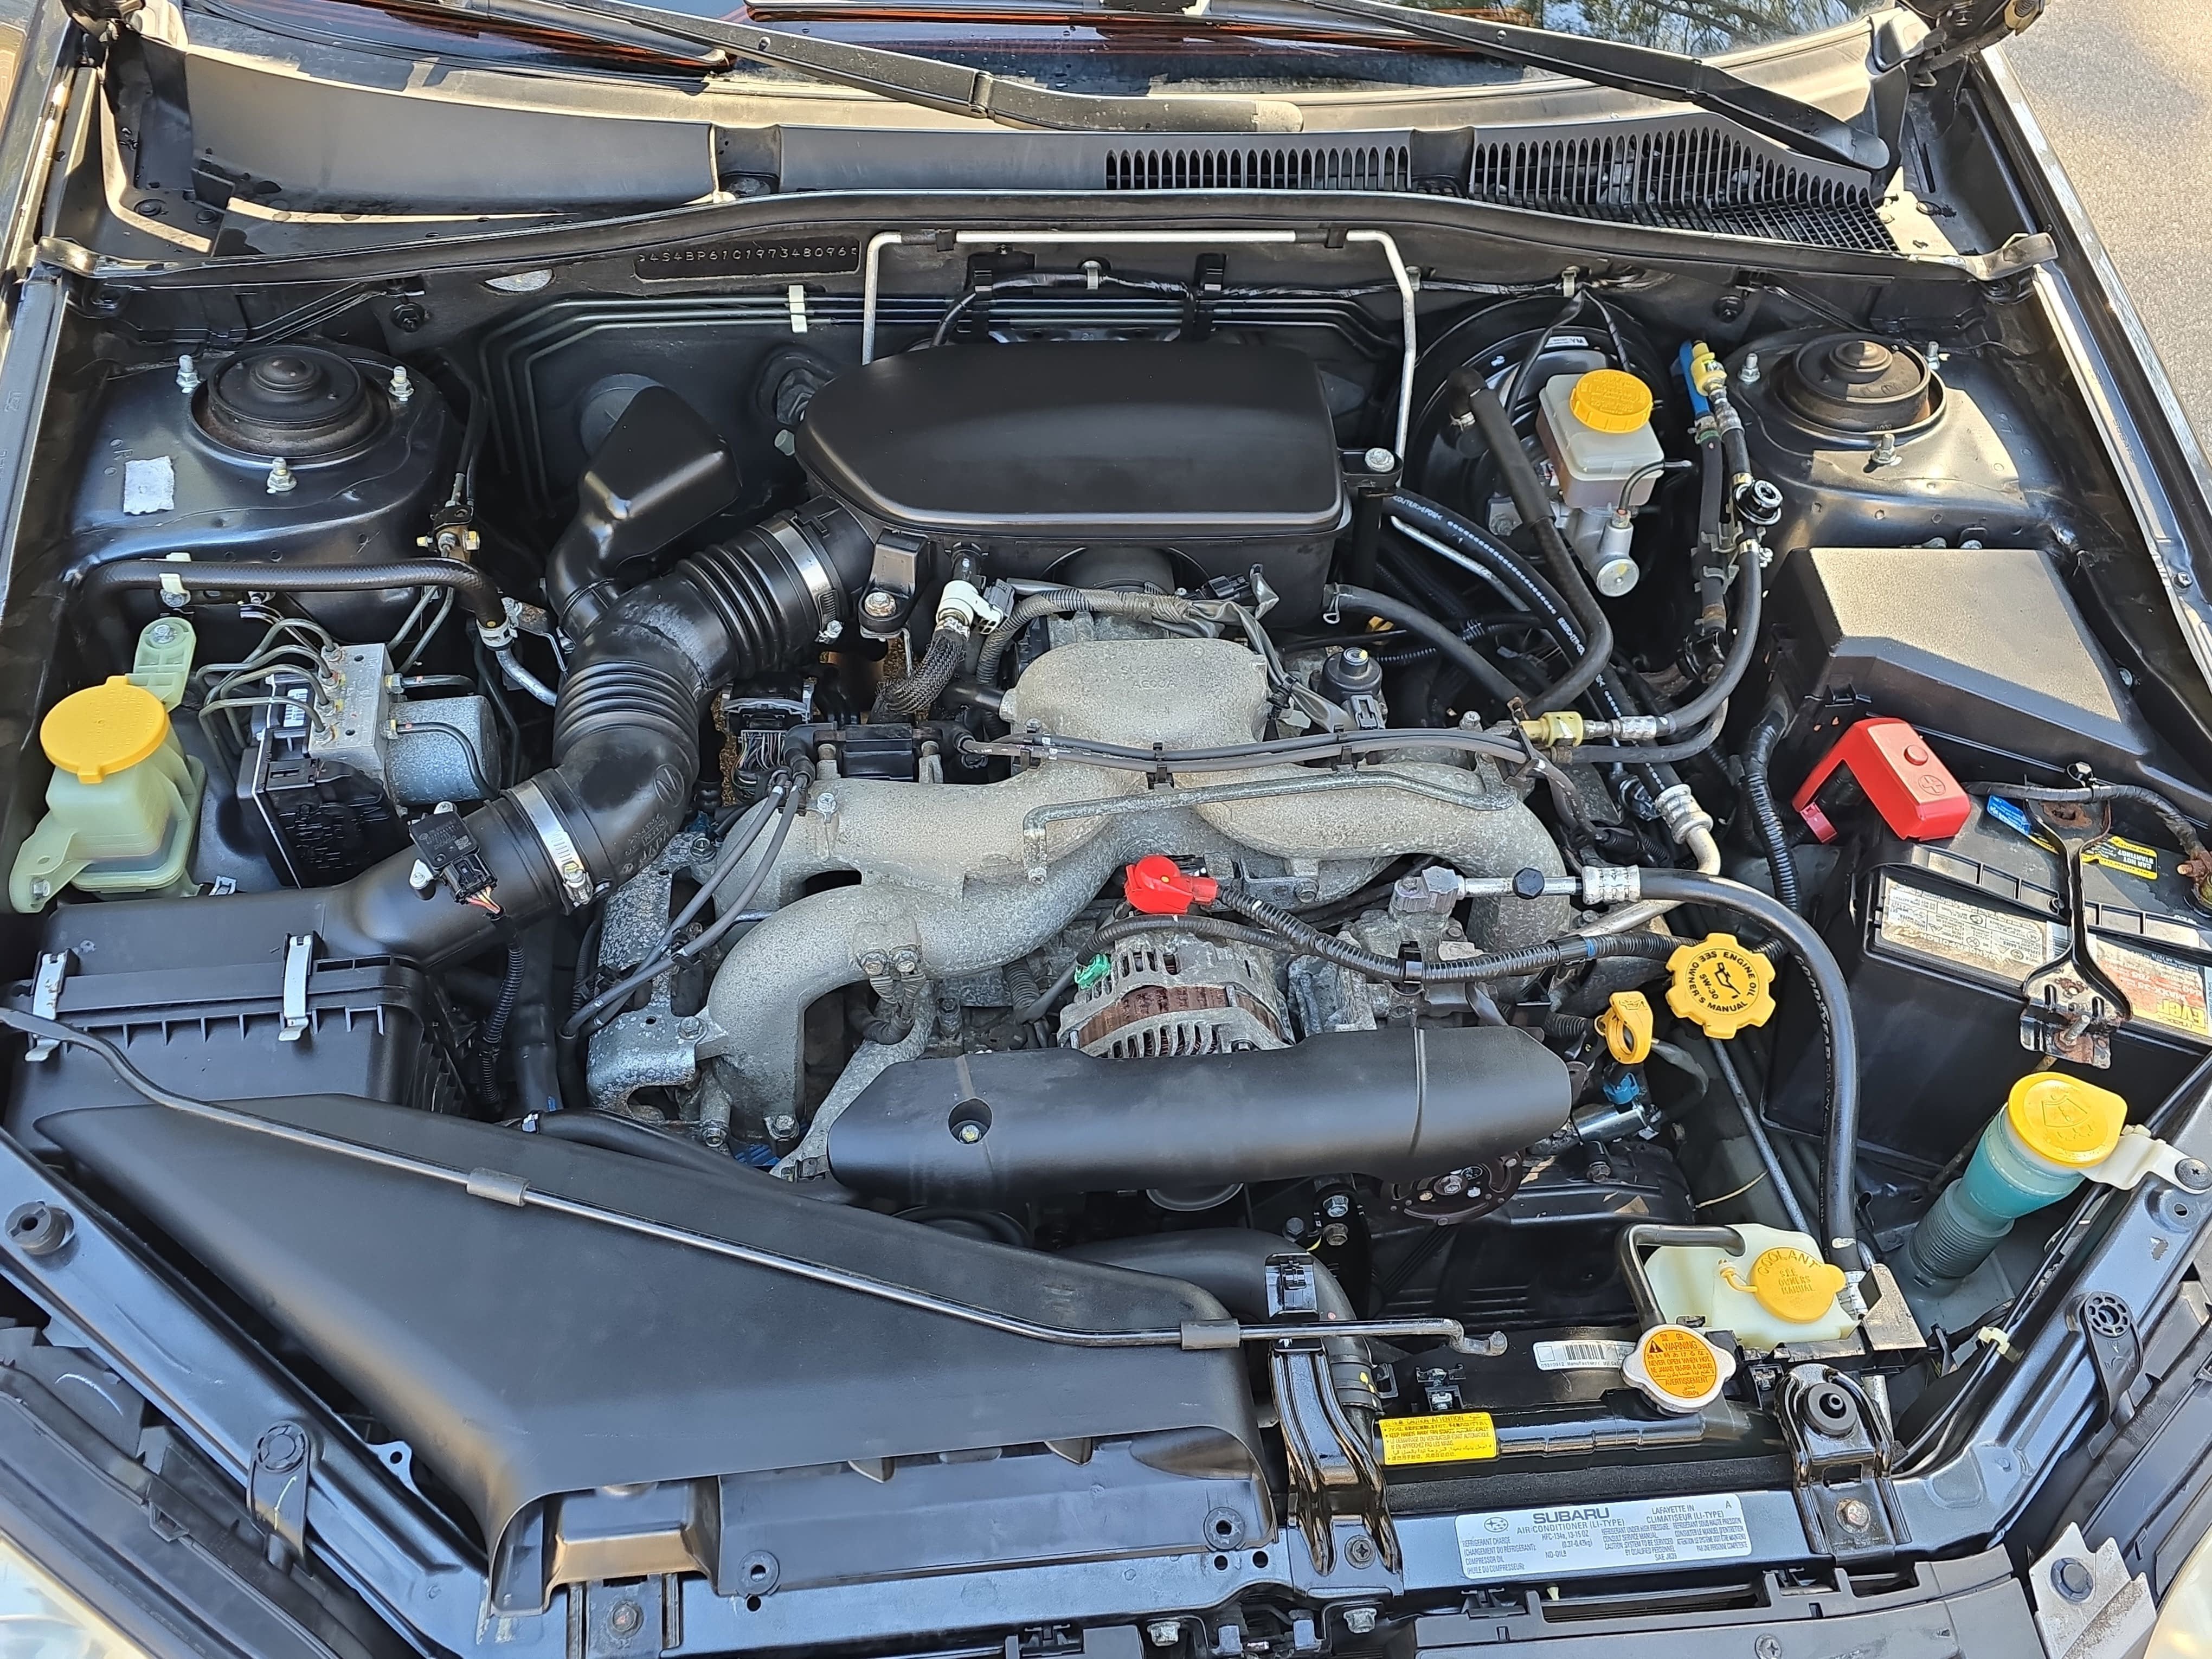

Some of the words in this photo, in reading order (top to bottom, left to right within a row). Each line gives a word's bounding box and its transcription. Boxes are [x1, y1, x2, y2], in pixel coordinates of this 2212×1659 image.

[1698, 950, 1718, 962] SEE
[1723, 951, 1756, 979] ENGINE
[1747, 982, 1757, 996] OIL
[1687, 962, 1706, 1004] OWNER'S
[1699, 973, 1719, 1000] 5W-30
[1707, 1001, 1748, 1012] MANUAL
[1757, 1250, 1819, 1275] COOLANT
[1779, 1268, 1797, 1277] SEE
[1662, 1340, 1698, 1351] WARNING
[1665, 1376, 1708, 1386] AVERTISSEMENT
[1432, 1414, 1464, 1423] ATTENTION
[1651, 1505, 1686, 1514] LAFAYETTE
[1726, 1500, 1732, 1509] A
[1533, 1507, 1610, 1524] SUBARU
[1647, 1513, 1692, 1523] CLIMATISEUR
[1694, 1510, 1724, 1520] (LI-TYPE)
[1533, 1521, 1588, 1533] CONDITIONER
[1590, 1518, 1624, 1529] (LI-TYPE)
[1567, 1531, 1581, 1539] 13-15
[1462, 1538, 1491, 1547] REFRIGERANT
[1465, 1556, 1496, 1565] COMPRESSOR
